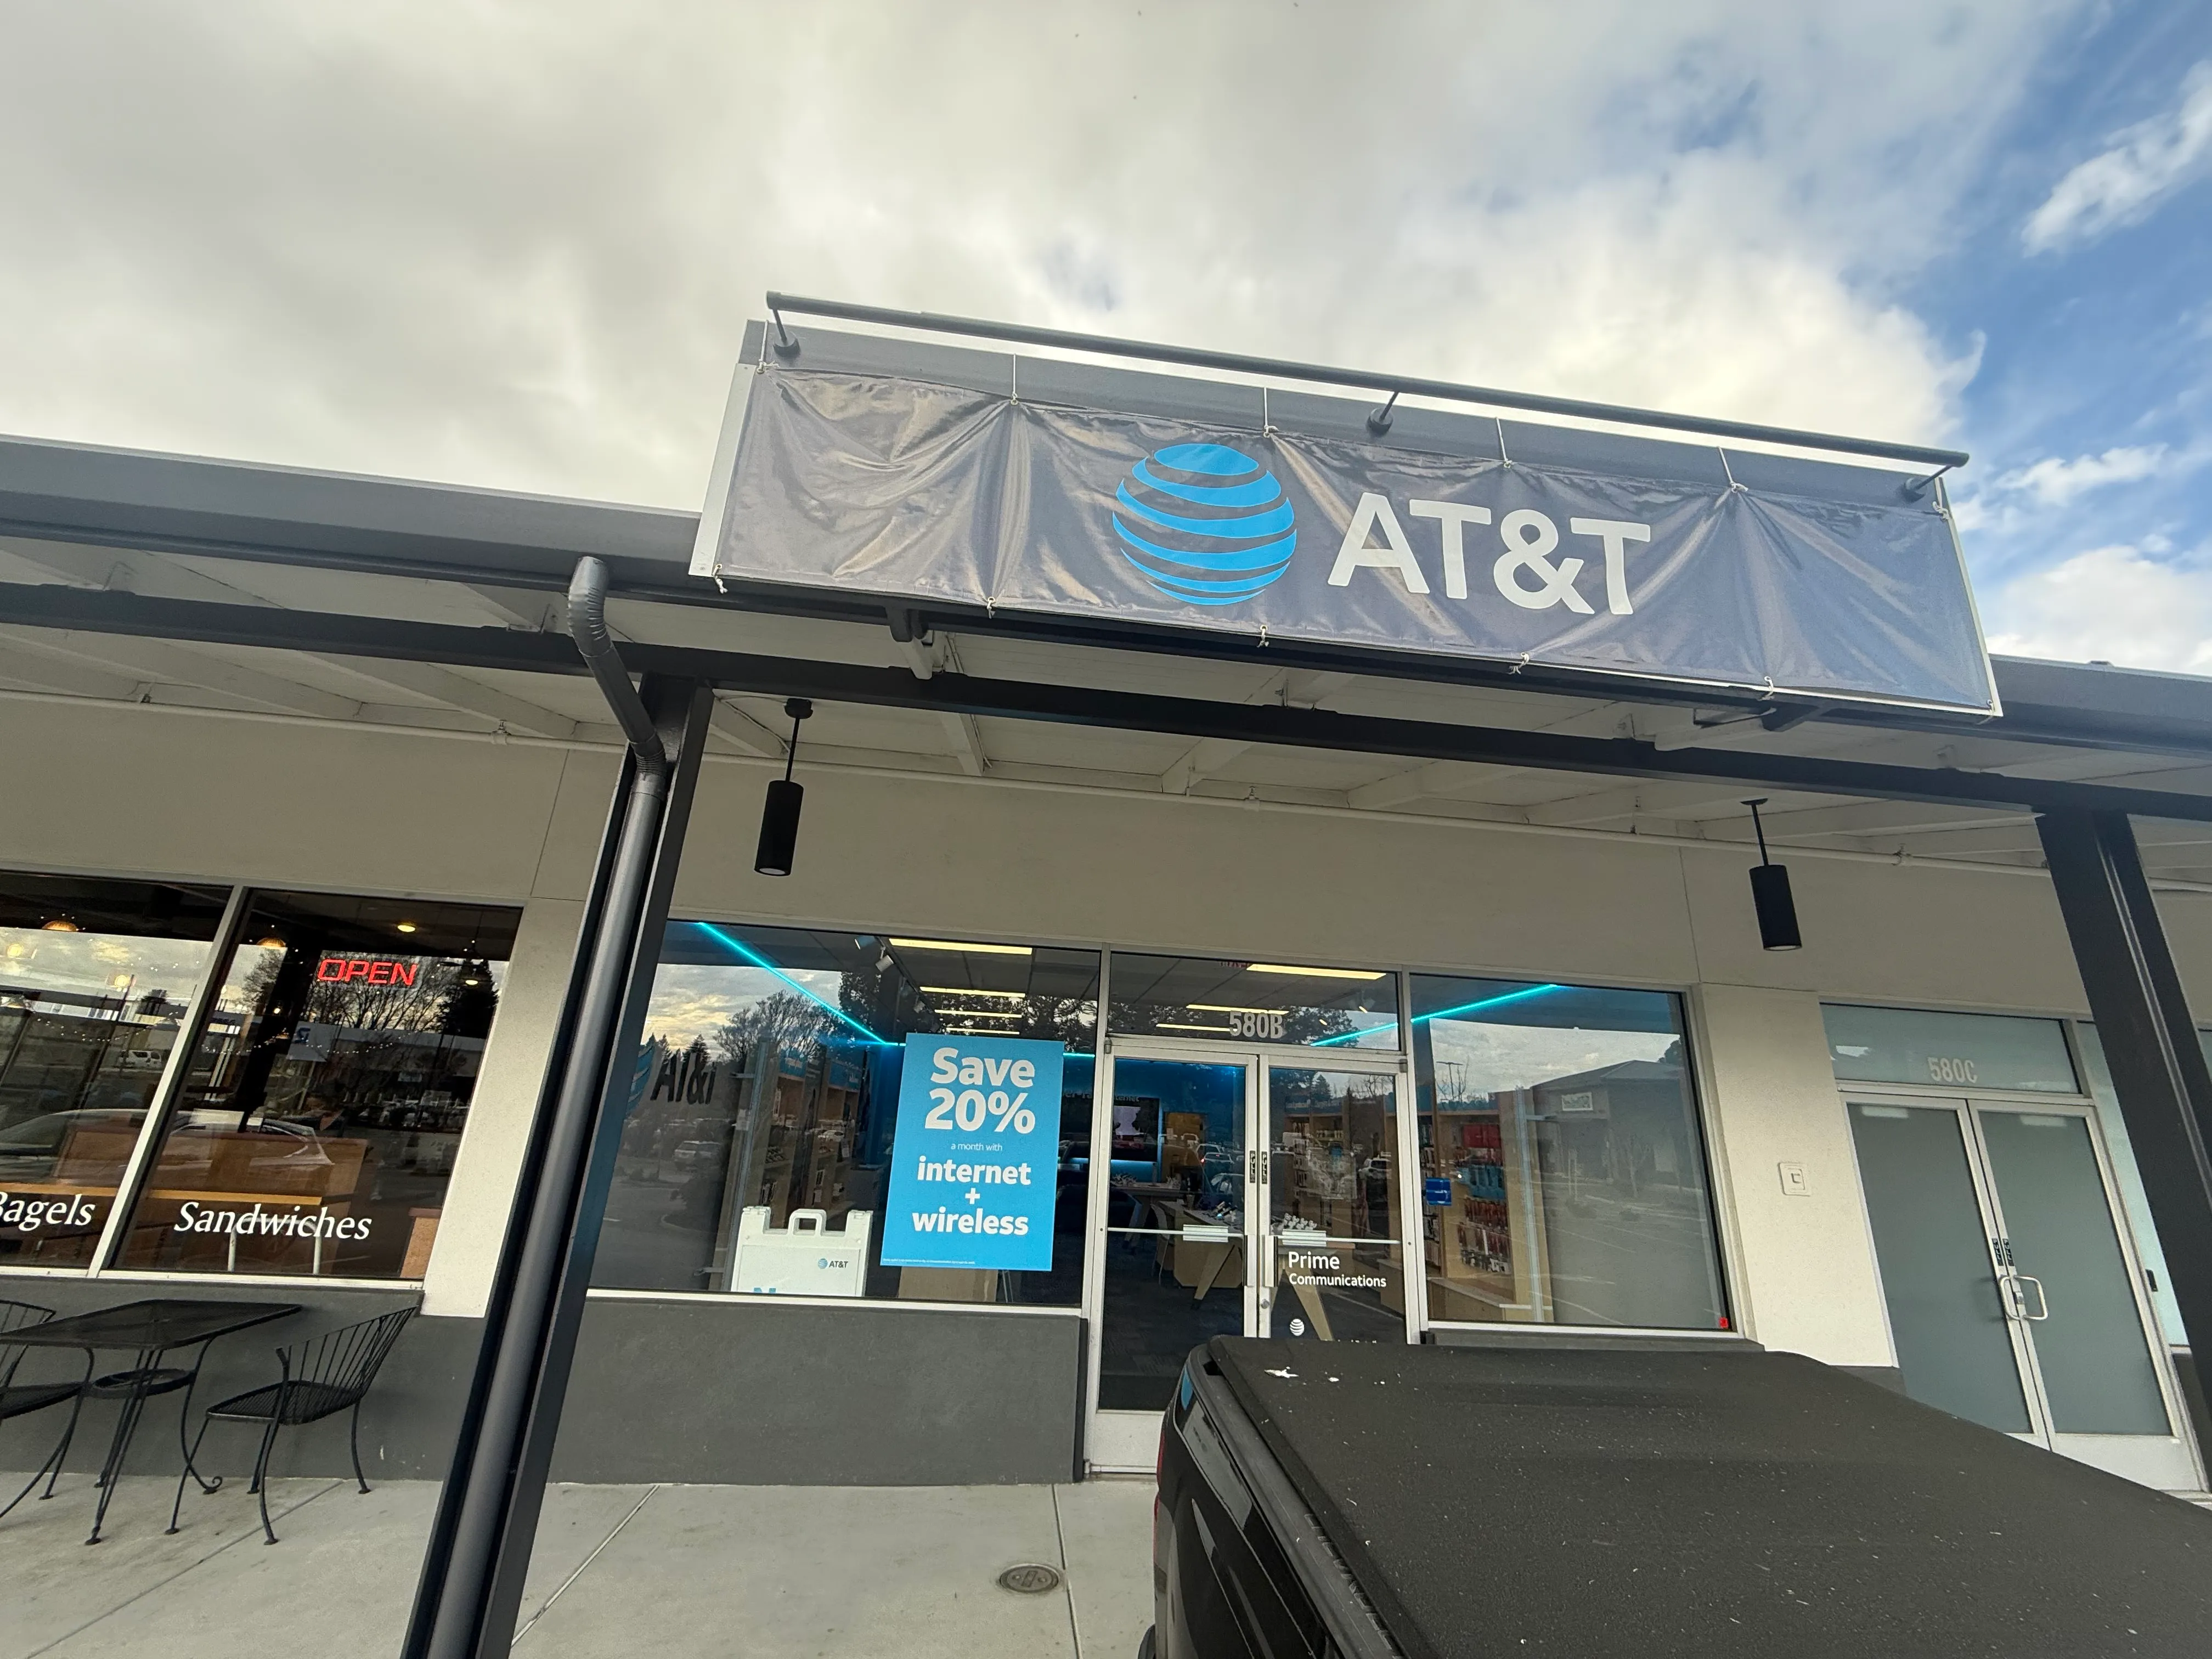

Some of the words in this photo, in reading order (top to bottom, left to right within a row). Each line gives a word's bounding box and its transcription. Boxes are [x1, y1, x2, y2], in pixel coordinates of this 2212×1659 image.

[1327, 492, 1651, 615] AT&T
[318, 959, 417, 985] OPEN
[1229, 1010, 1284, 1039] 580B
[930, 1047, 1035, 1088] Save
[1927, 1057, 1978, 1083] 580C
[925, 1088, 1036, 1134] 20%
[957, 1143, 984, 1151] month
[986, 1143, 1003, 1152] with
[917, 1155, 1031, 1186] internet
[965, 1187, 980, 1204] +
[174, 1201, 373, 1240] Sandwiches
[912, 1206, 1029, 1235] wireless
[829, 1260, 849, 1268] AT&T
[1289, 1251, 1340, 1270] Prime
[1289, 1273, 1387, 1288] Communications
